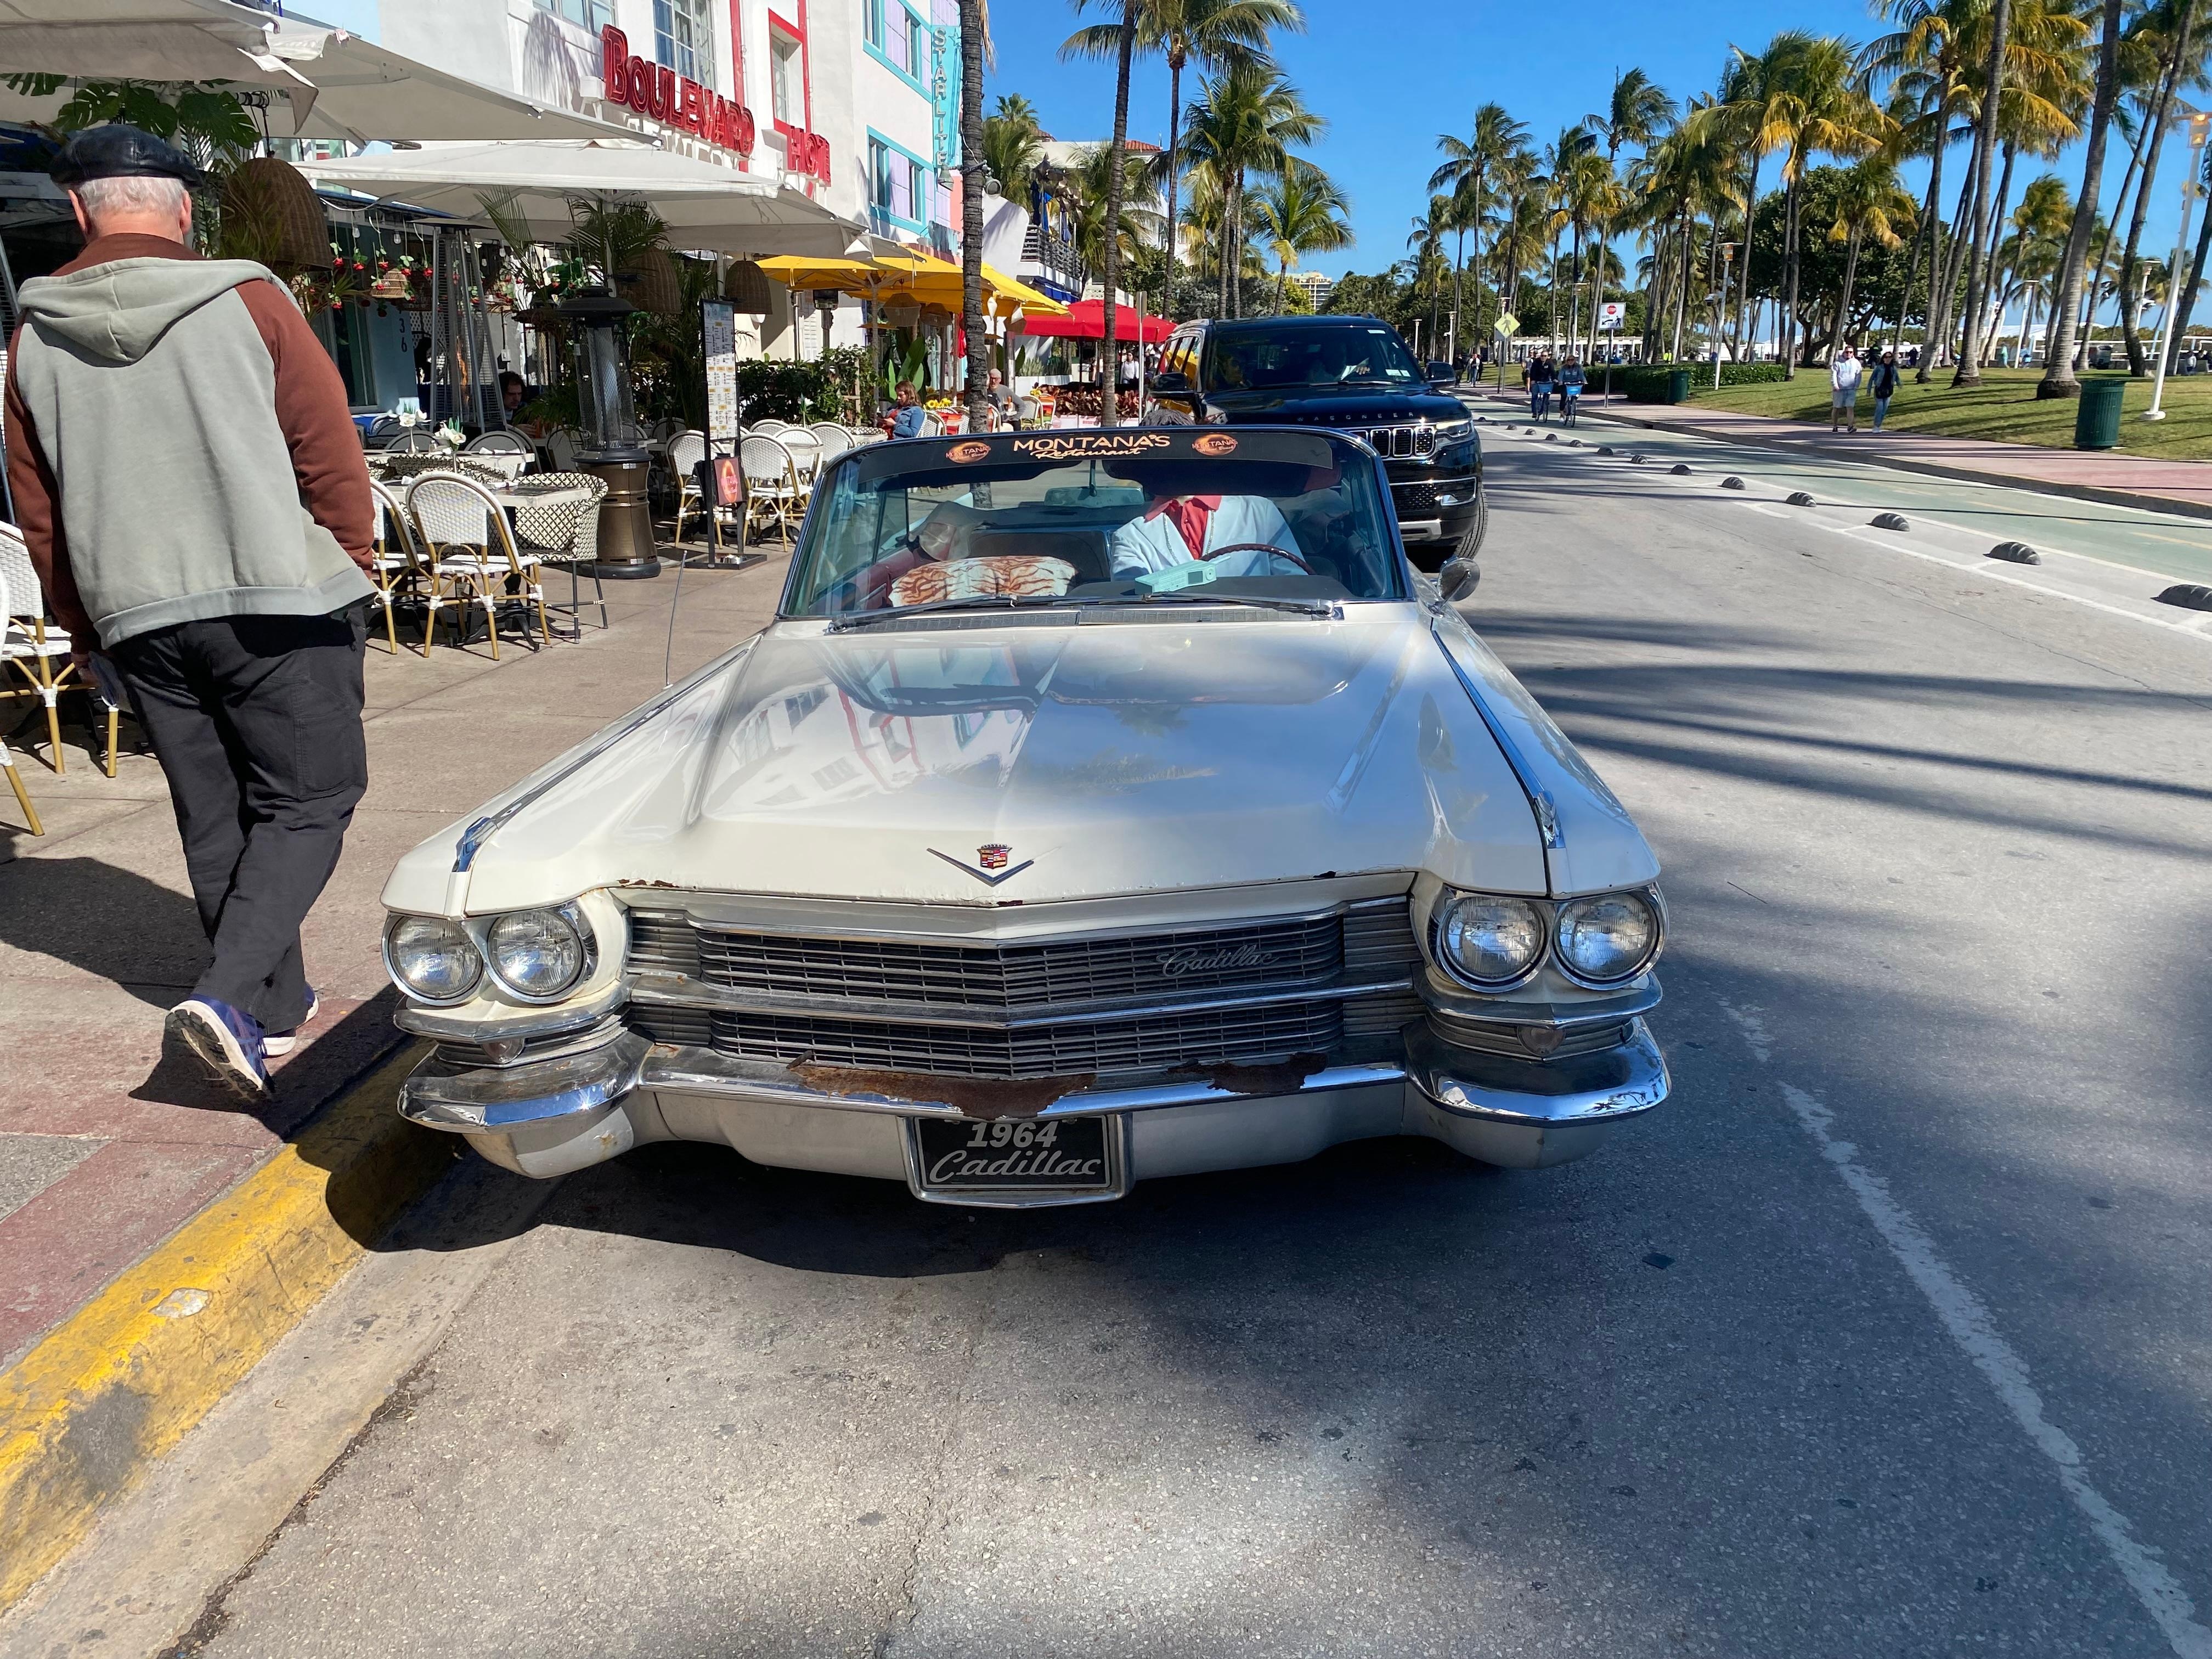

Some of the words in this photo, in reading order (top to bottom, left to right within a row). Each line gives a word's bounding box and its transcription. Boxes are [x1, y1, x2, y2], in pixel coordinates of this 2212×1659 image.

[601, 24, 755, 158] BOULEVARD
[934, 27, 947, 165] STARLITE
[399, 310, 408, 352] 36
[1014, 434, 1170, 452] MONTANA'S
[1030, 447, 1147, 459] Restaurant
[1156, 944, 1280, 977] Cadillac
[966, 1121, 1059, 1148] 1964
[929, 1150, 1101, 1183] Cadillac
